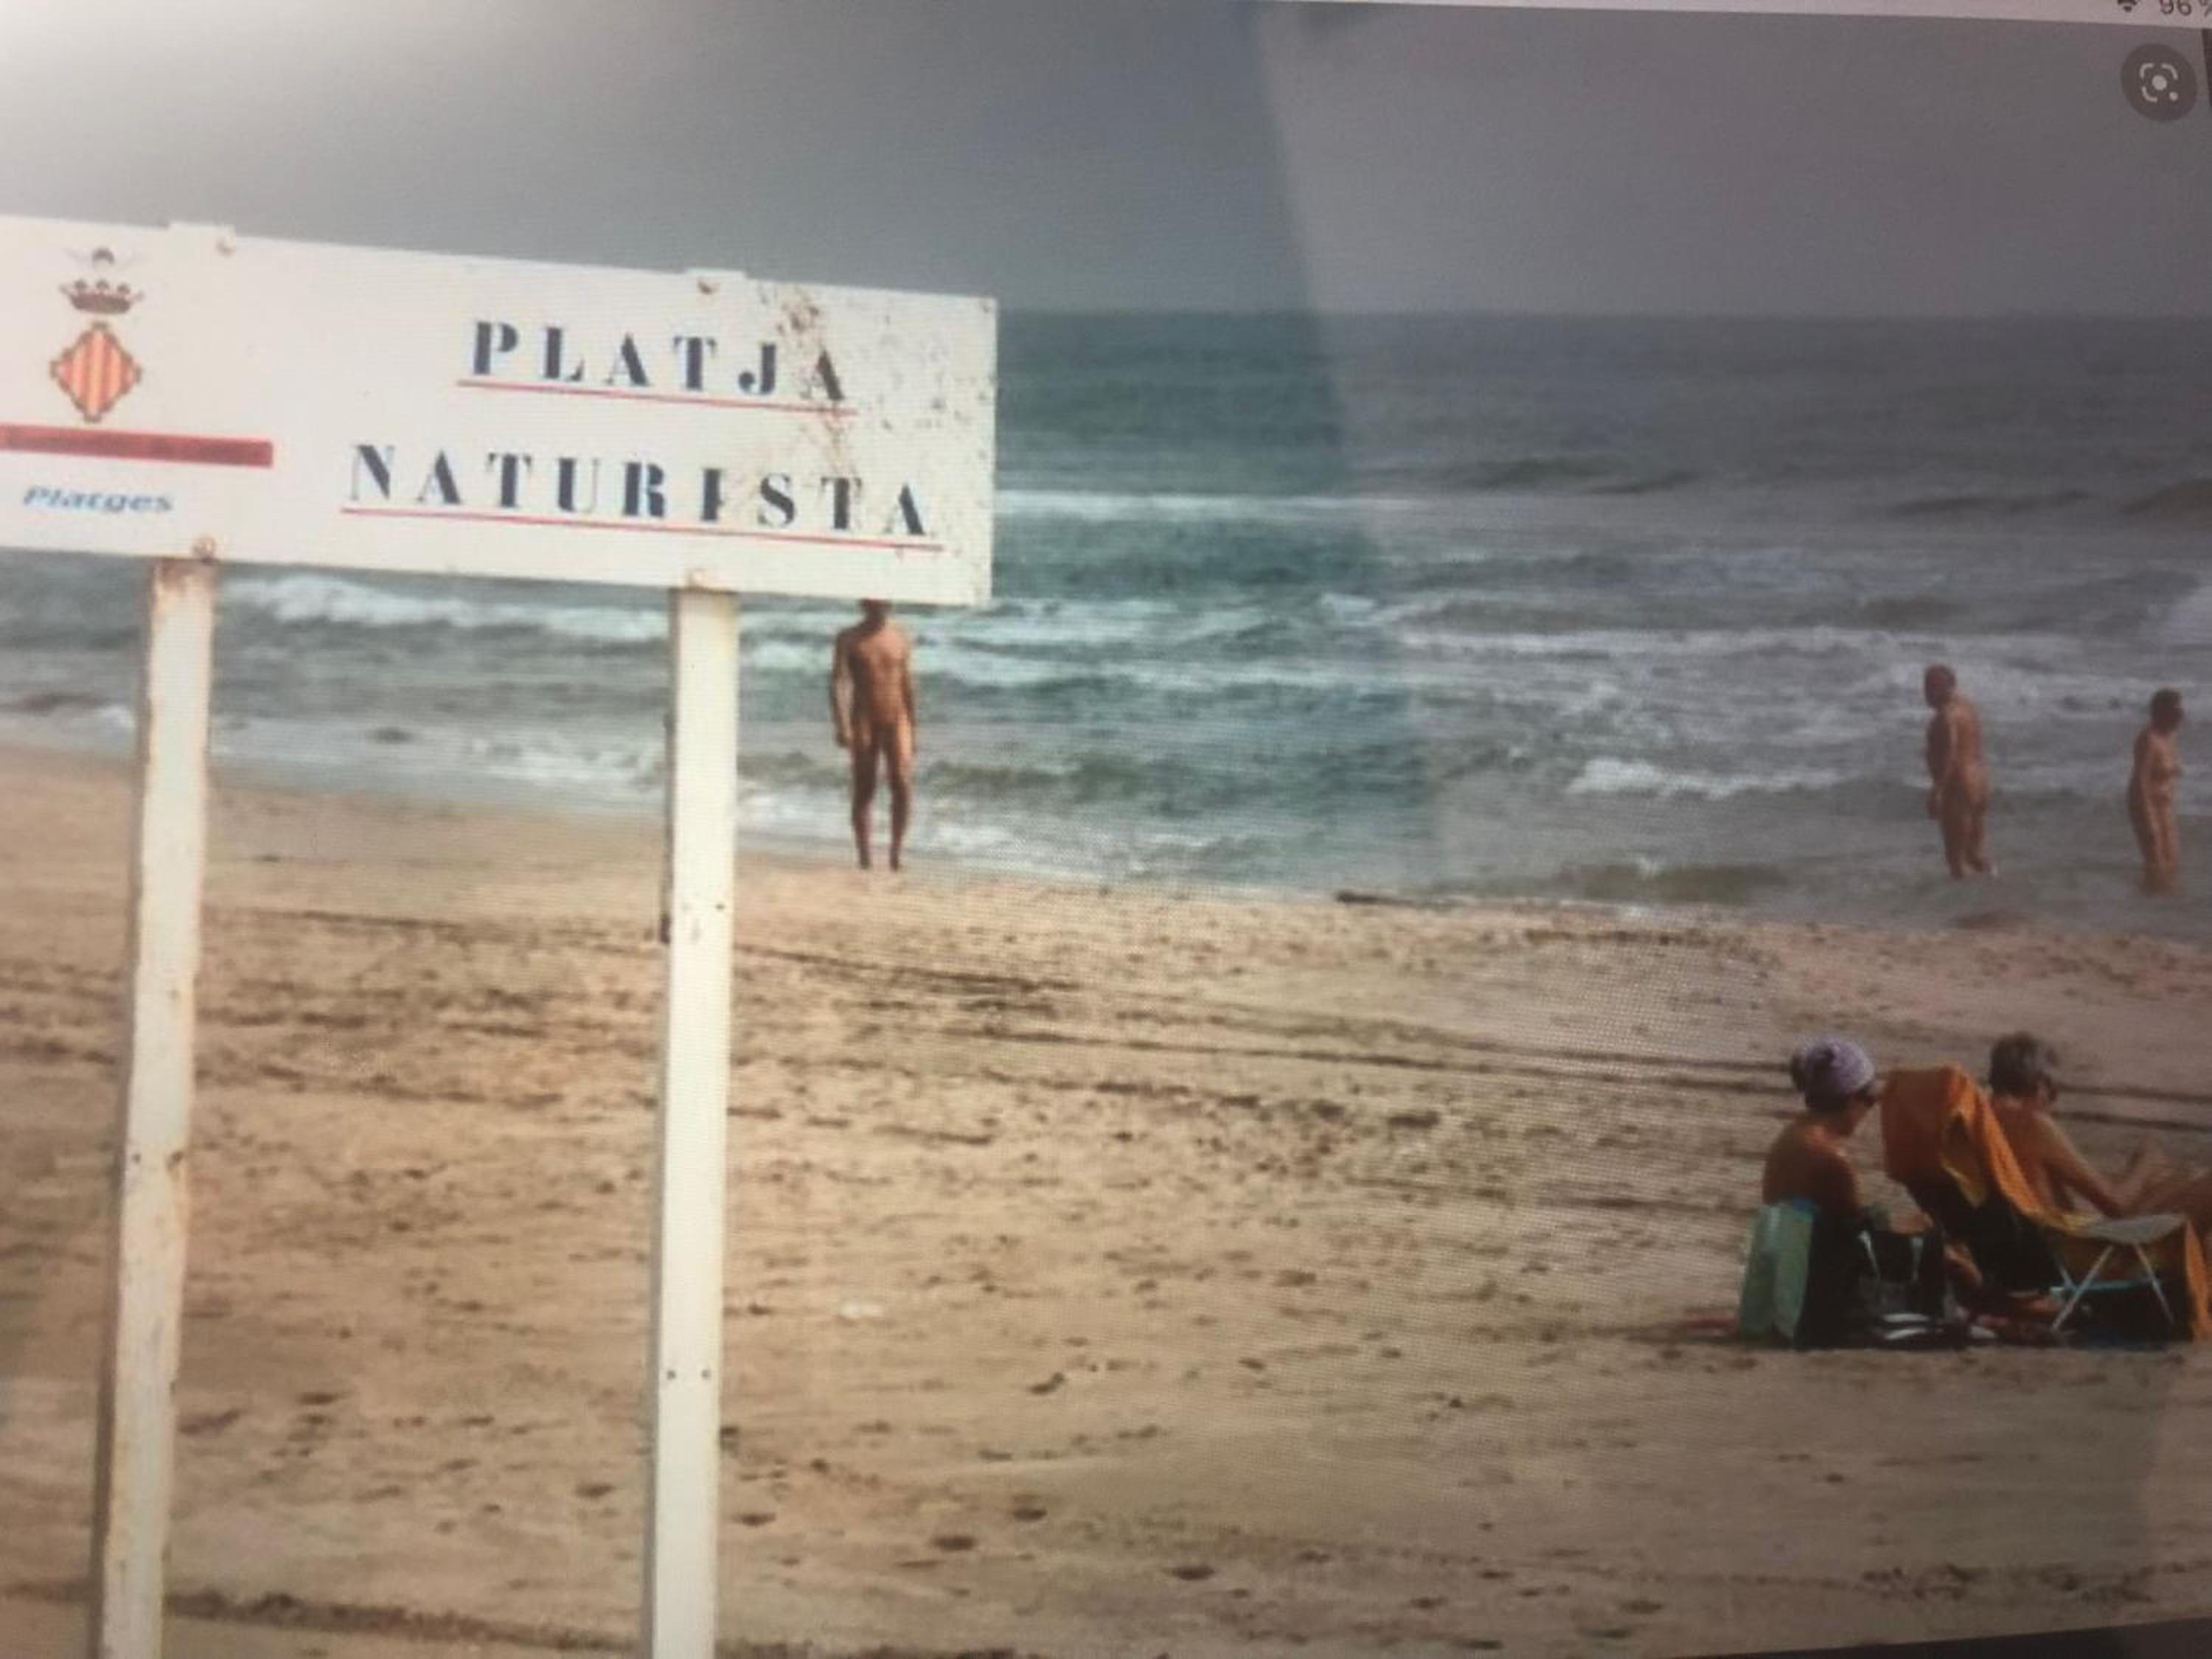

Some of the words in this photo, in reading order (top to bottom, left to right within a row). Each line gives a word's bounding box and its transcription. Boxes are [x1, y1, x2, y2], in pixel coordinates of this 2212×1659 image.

[470, 319, 844, 402] PLATJA
[24, 485, 173, 514] Platges
[350, 444, 929, 537] NATURISTA
